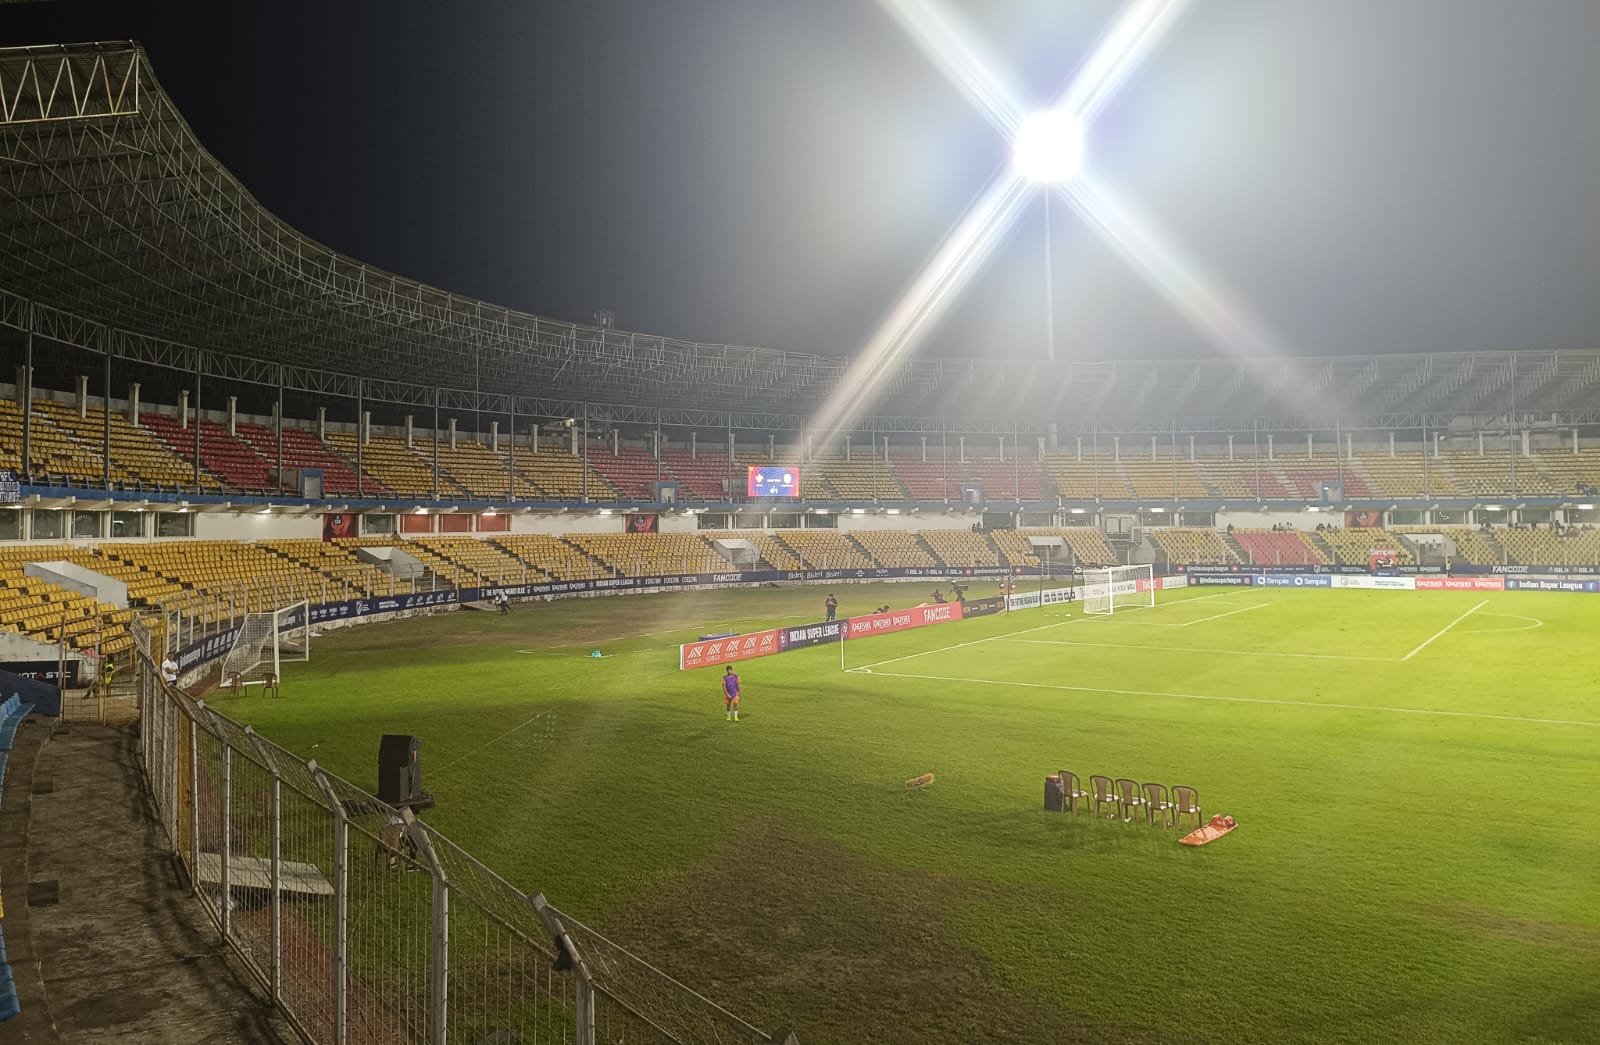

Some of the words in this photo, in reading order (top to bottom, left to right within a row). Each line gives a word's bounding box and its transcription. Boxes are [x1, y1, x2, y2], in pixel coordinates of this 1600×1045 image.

[1492, 565, 1529, 574] FANCODE
[713, 573, 743, 582] FANCODE
[1266, 576, 1290, 586] Simple
[1304, 576, 1328, 586] Simple
[1519, 580, 1539, 588] Indian
[1540, 581, 1558, 590] Super
[1560, 582, 1583, 590] League
[923, 606, 951, 624] FANCODE
[789, 629, 807, 642] INDIAN
[807, 626, 823, 640] SUPER
[823, 623, 840, 637] LEAGUE
